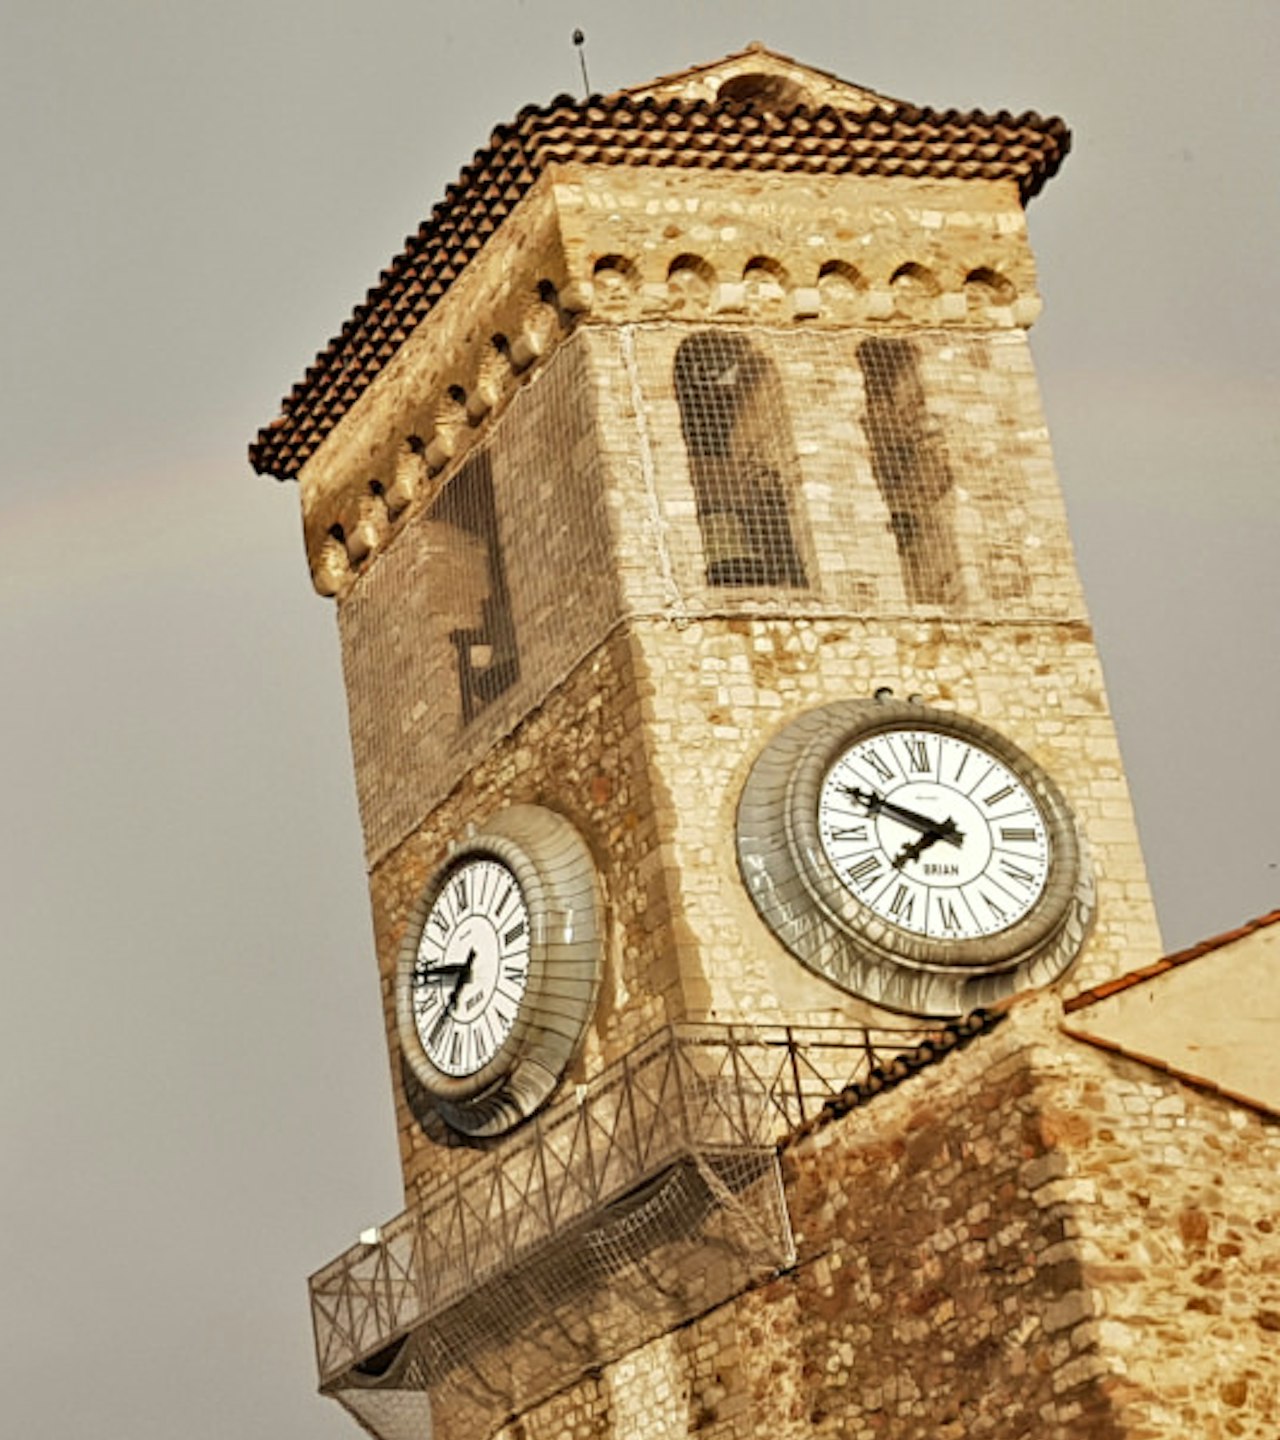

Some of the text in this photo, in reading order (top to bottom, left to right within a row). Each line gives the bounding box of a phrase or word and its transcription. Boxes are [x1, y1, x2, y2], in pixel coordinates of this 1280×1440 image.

[861, 748, 896, 784] XI
[902, 740, 933, 773] XII
[982, 785, 1015, 807] II
[829, 824, 868, 842] IX
[999, 827, 1038, 842] III
[846, 855, 885, 893] VIII
[923, 863, 959, 876] BRIAN
[999, 858, 1036, 891] IV
[888, 883, 916, 922] VII
[937, 896, 962, 930] VI
[977, 889, 1007, 921] V
